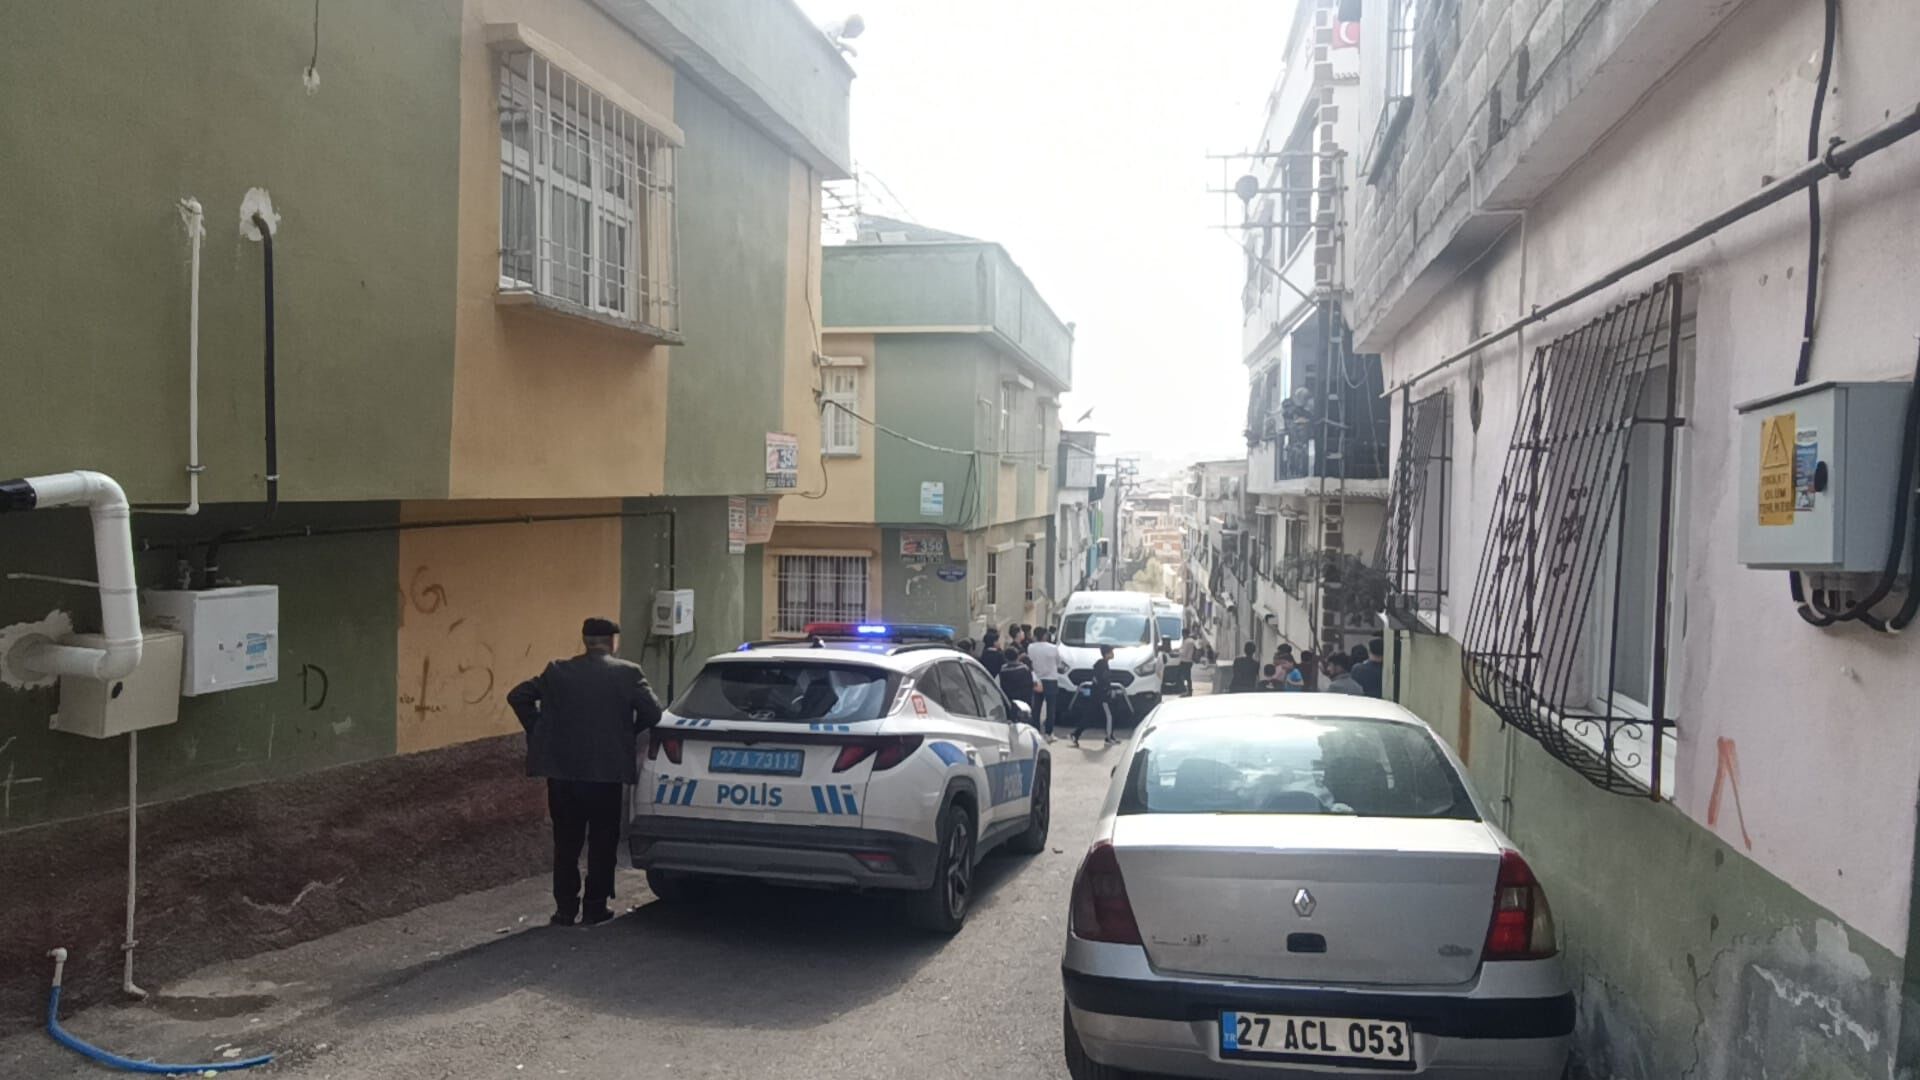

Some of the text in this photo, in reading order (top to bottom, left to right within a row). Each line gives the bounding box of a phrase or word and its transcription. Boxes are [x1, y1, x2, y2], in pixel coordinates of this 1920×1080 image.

[719, 750, 736, 766] 27
[717, 782, 783, 807] POLİS
[1236, 1016, 1271, 1047] 27
[1284, 1019, 1337, 1051] ACL
[1348, 1023, 1405, 1056] 053
